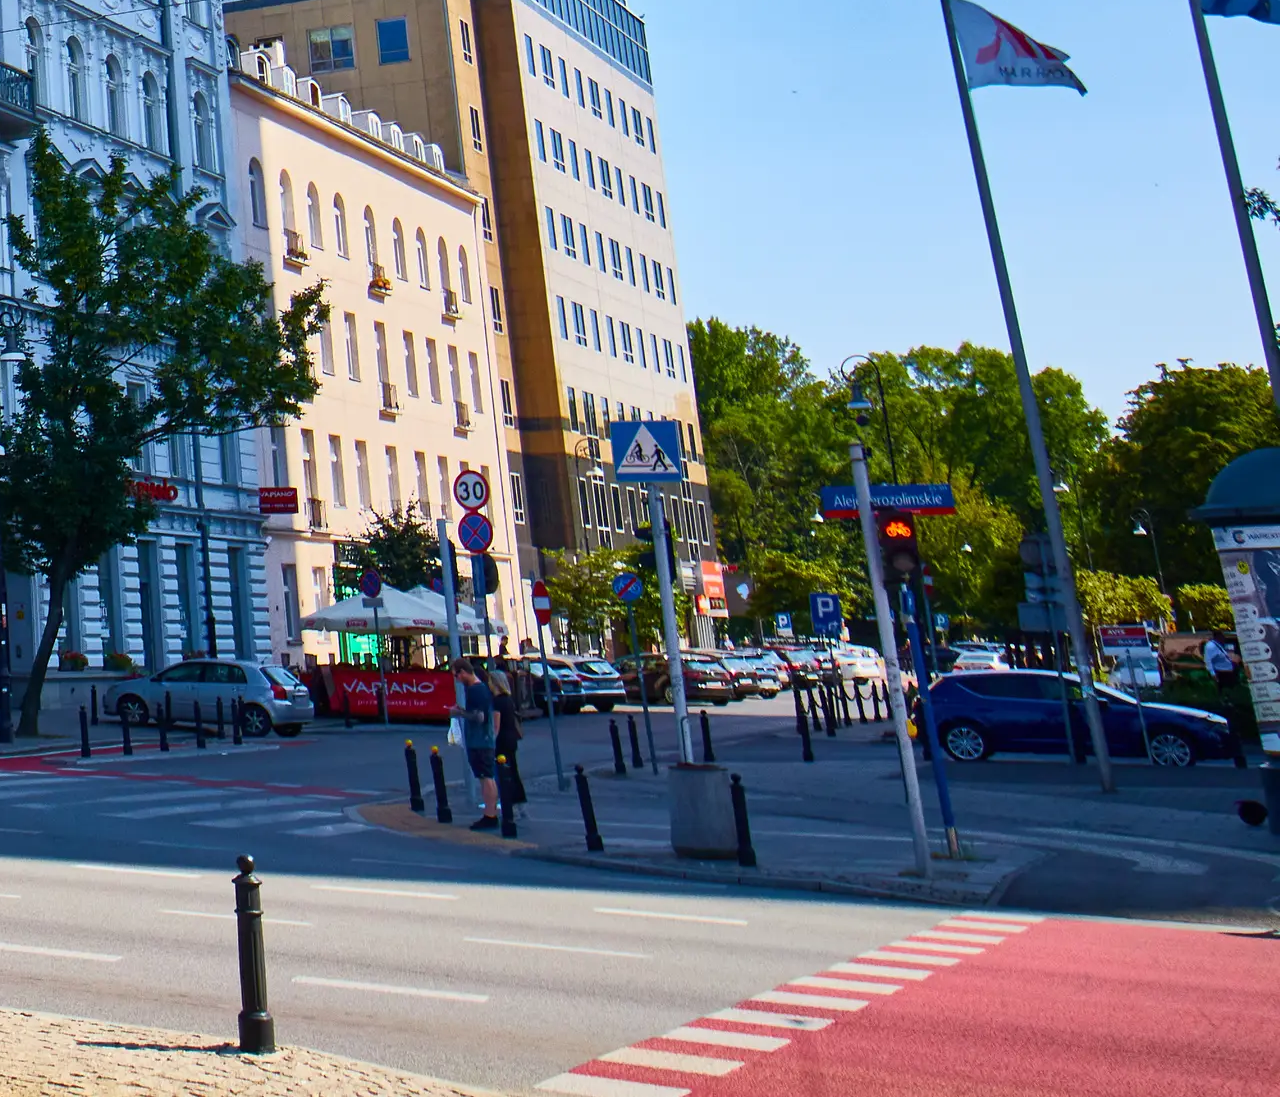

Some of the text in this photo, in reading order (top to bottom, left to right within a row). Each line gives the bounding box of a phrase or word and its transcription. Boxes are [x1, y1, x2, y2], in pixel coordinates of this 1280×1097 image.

[458, 481, 484, 501] 30
[834, 491, 942, 510] Alej erozolimskie
[817, 597, 834, 618] P
[778, 616, 788, 627] P
[343, 678, 435, 696] VAPIANO
